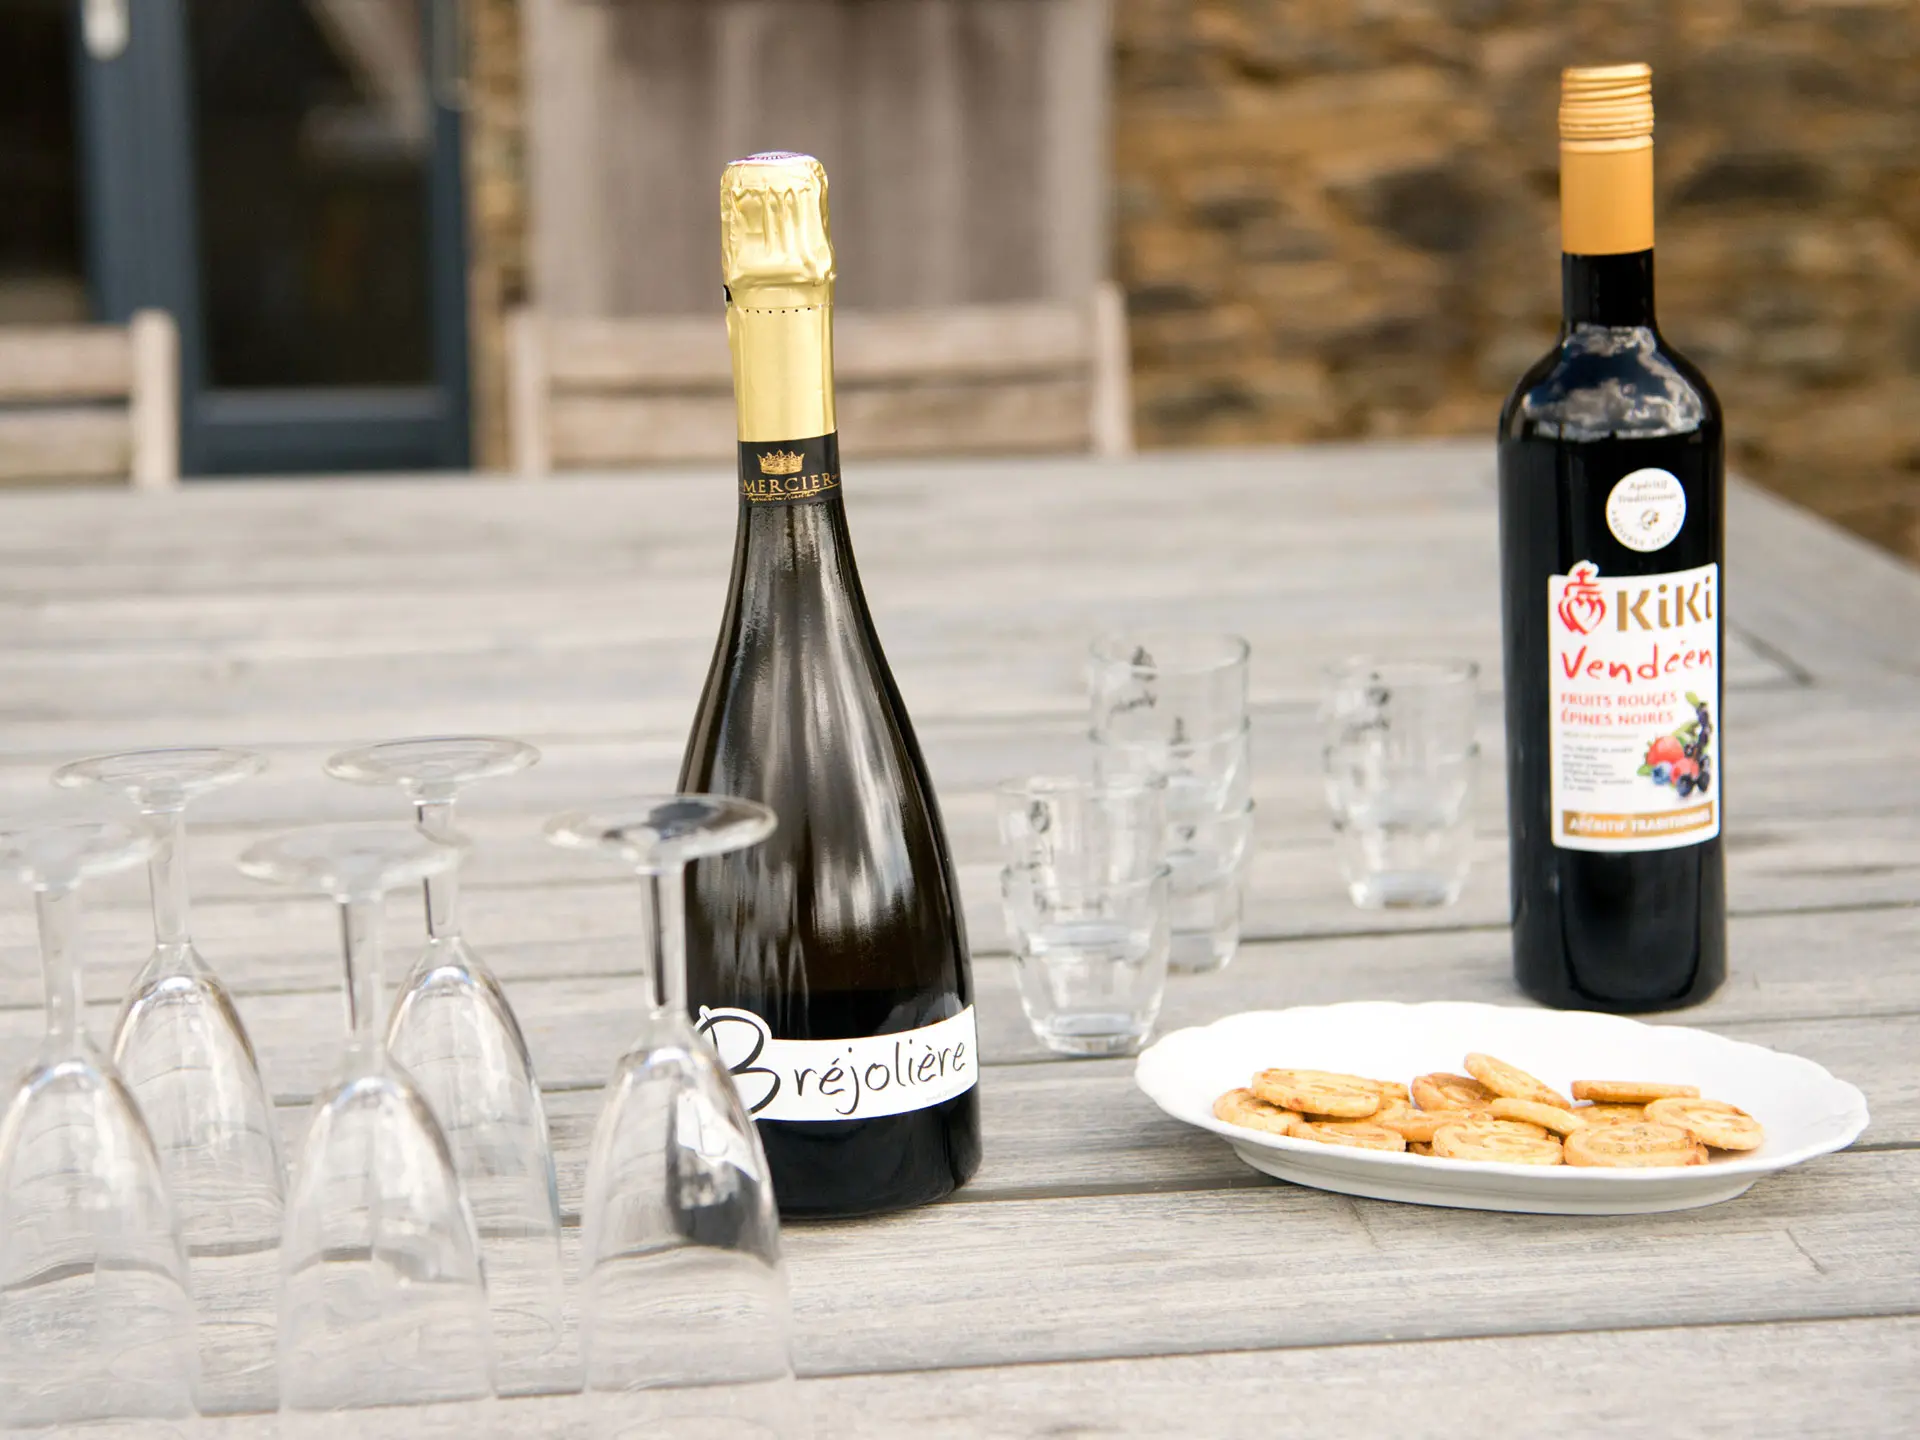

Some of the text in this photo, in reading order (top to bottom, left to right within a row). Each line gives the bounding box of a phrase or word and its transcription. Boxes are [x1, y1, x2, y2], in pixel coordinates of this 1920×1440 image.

[743, 473, 834, 493] MERCIER
[1561, 690, 1678, 709] FRUITS ROUGES
[1561, 709, 1674, 726] ÉPINES NOIRES
[697, 1013, 966, 1115] Bréjolière
